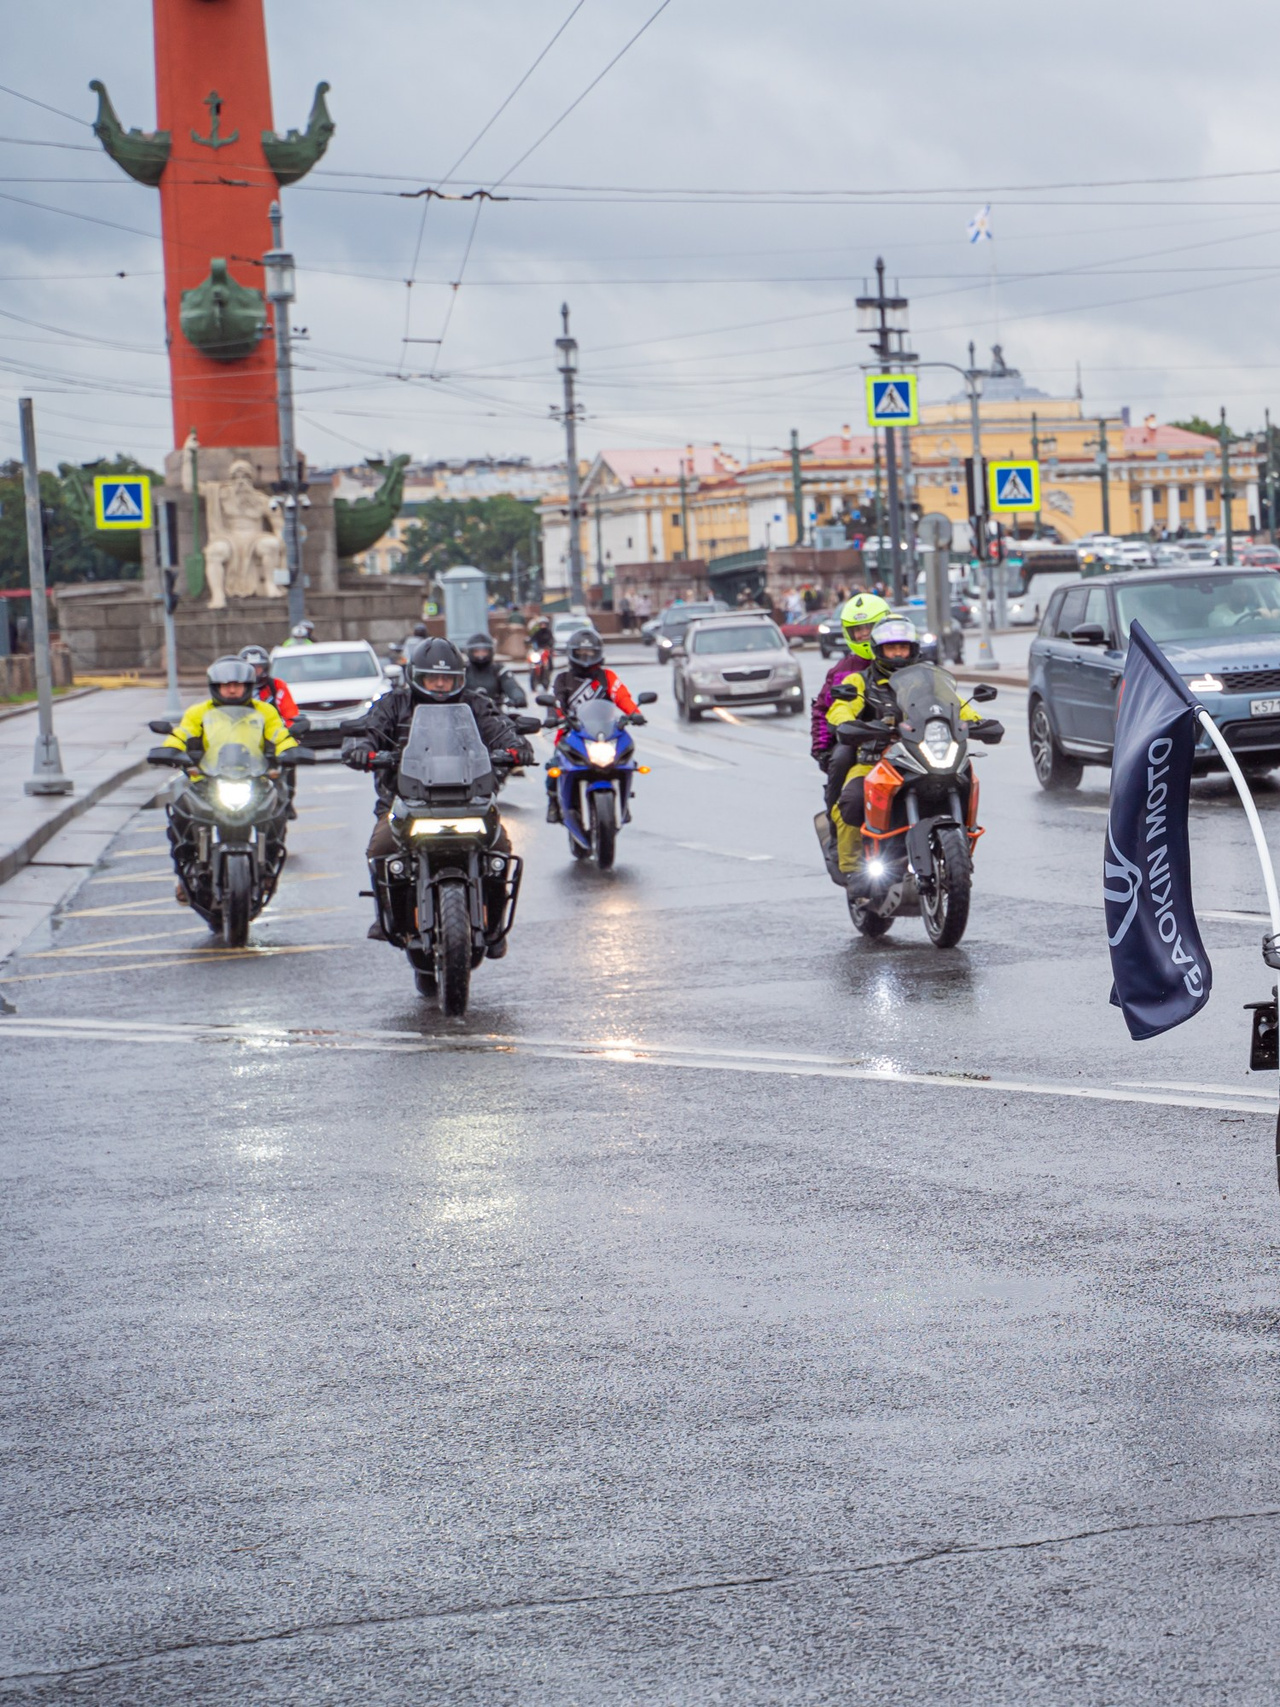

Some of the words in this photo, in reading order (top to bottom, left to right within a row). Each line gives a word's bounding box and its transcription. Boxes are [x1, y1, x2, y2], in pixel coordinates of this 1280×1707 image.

[1222, 663, 1270, 671] RANGE
[1146, 737, 1173, 843] MOTO
[1147, 844, 1204, 998] GAOKIN
